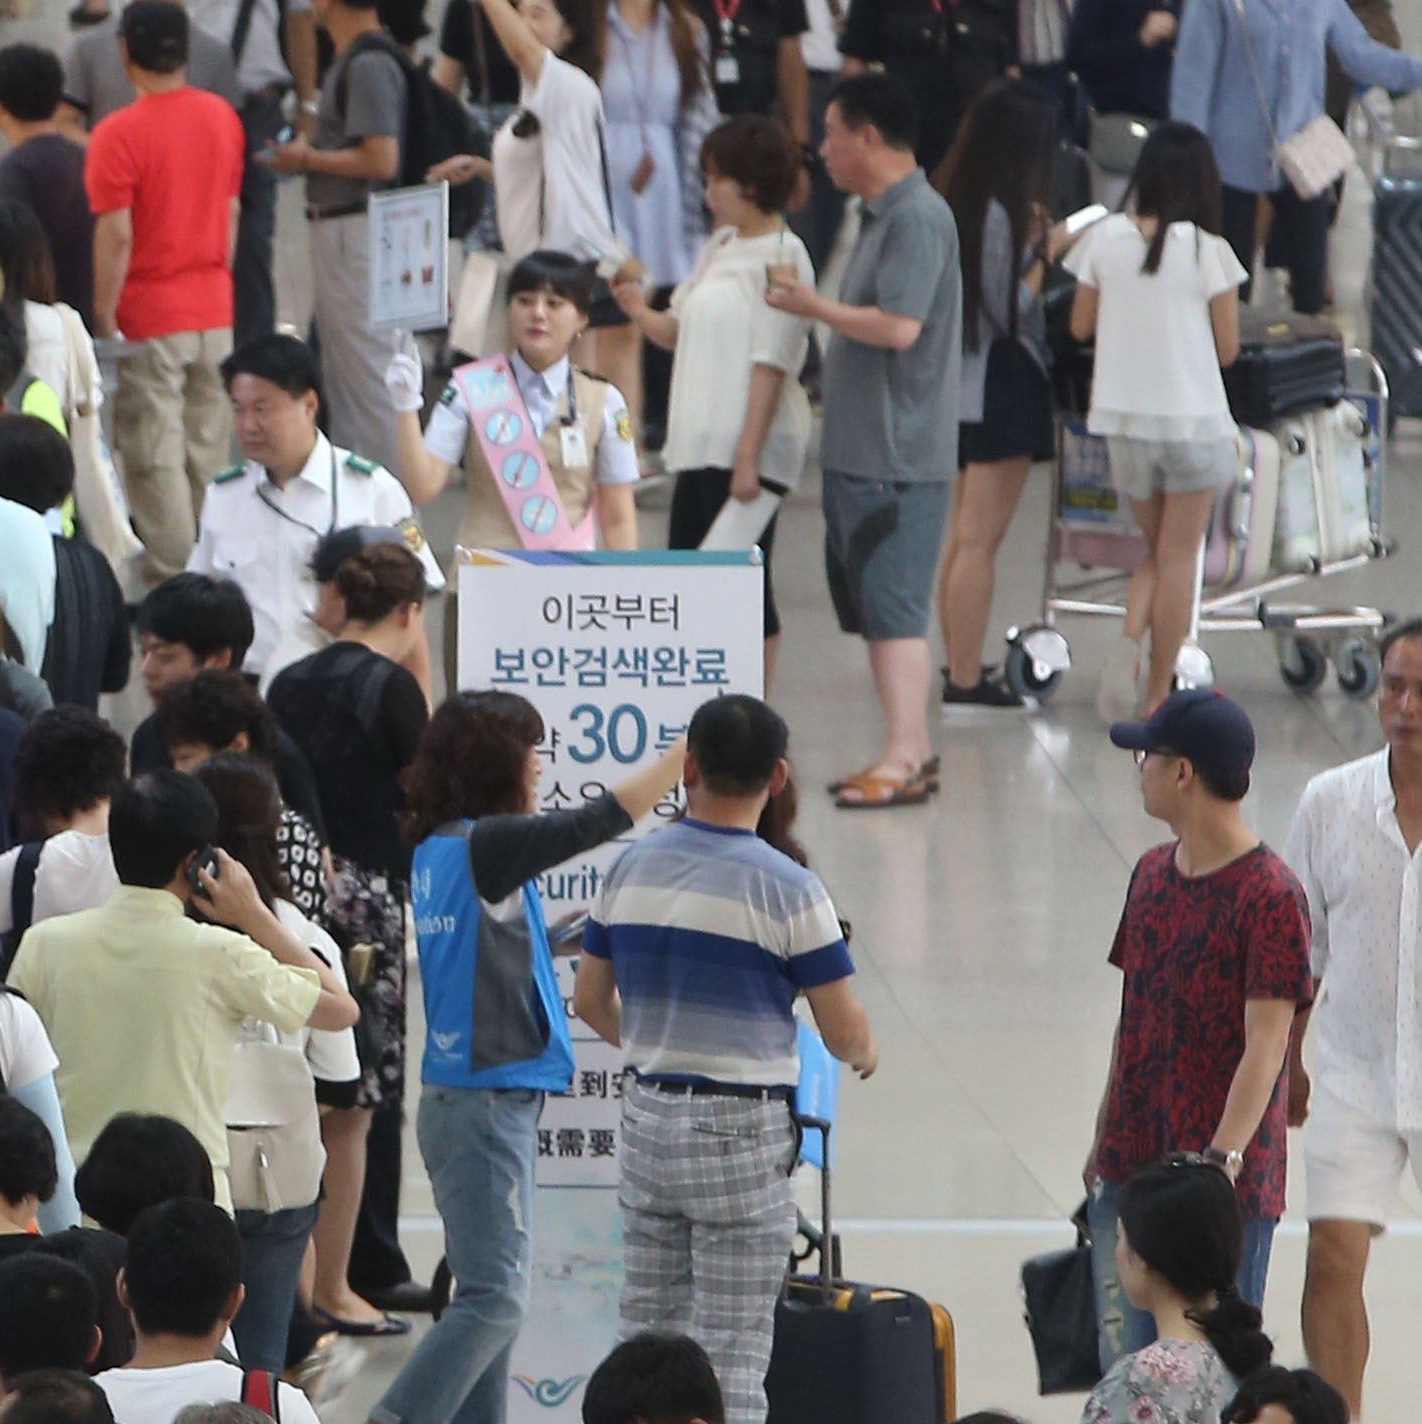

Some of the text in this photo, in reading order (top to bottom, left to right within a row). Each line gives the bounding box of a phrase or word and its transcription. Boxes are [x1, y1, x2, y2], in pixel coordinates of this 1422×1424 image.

[542, 593, 681, 631] 이곳부터
[490, 646, 730, 687] 보안검색완료
[567, 703, 648, 764] 30
